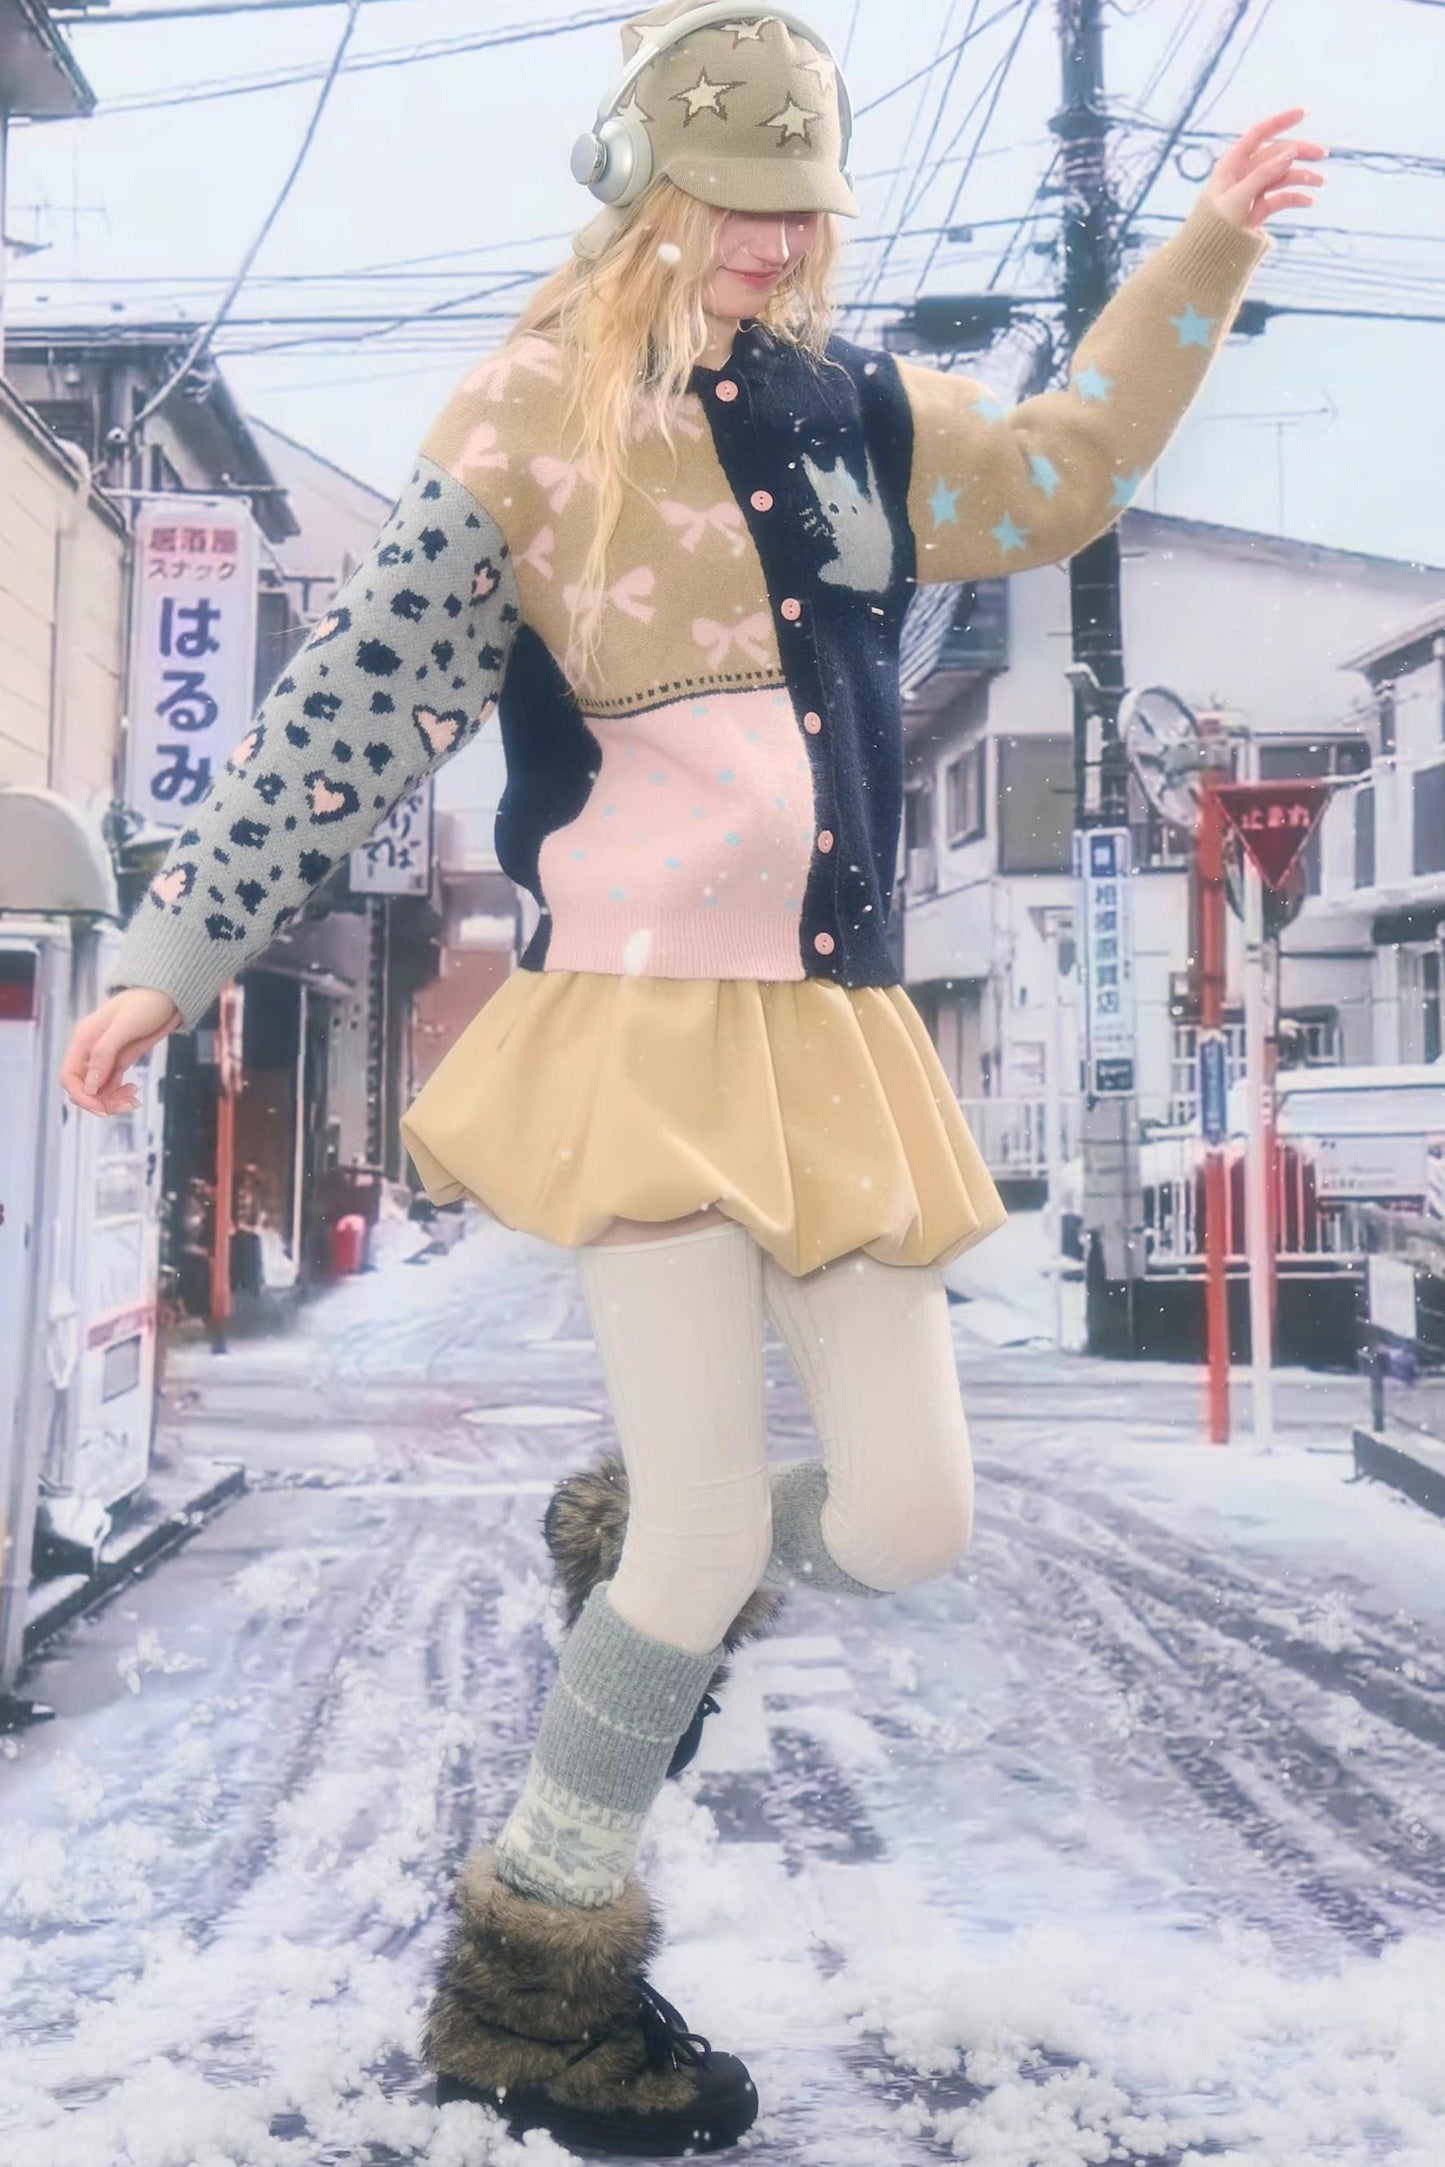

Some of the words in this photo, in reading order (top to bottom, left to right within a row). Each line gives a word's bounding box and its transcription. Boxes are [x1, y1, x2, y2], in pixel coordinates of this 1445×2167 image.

[148, 559, 236, 581] スナック
[151, 597, 221, 806] はるみ
